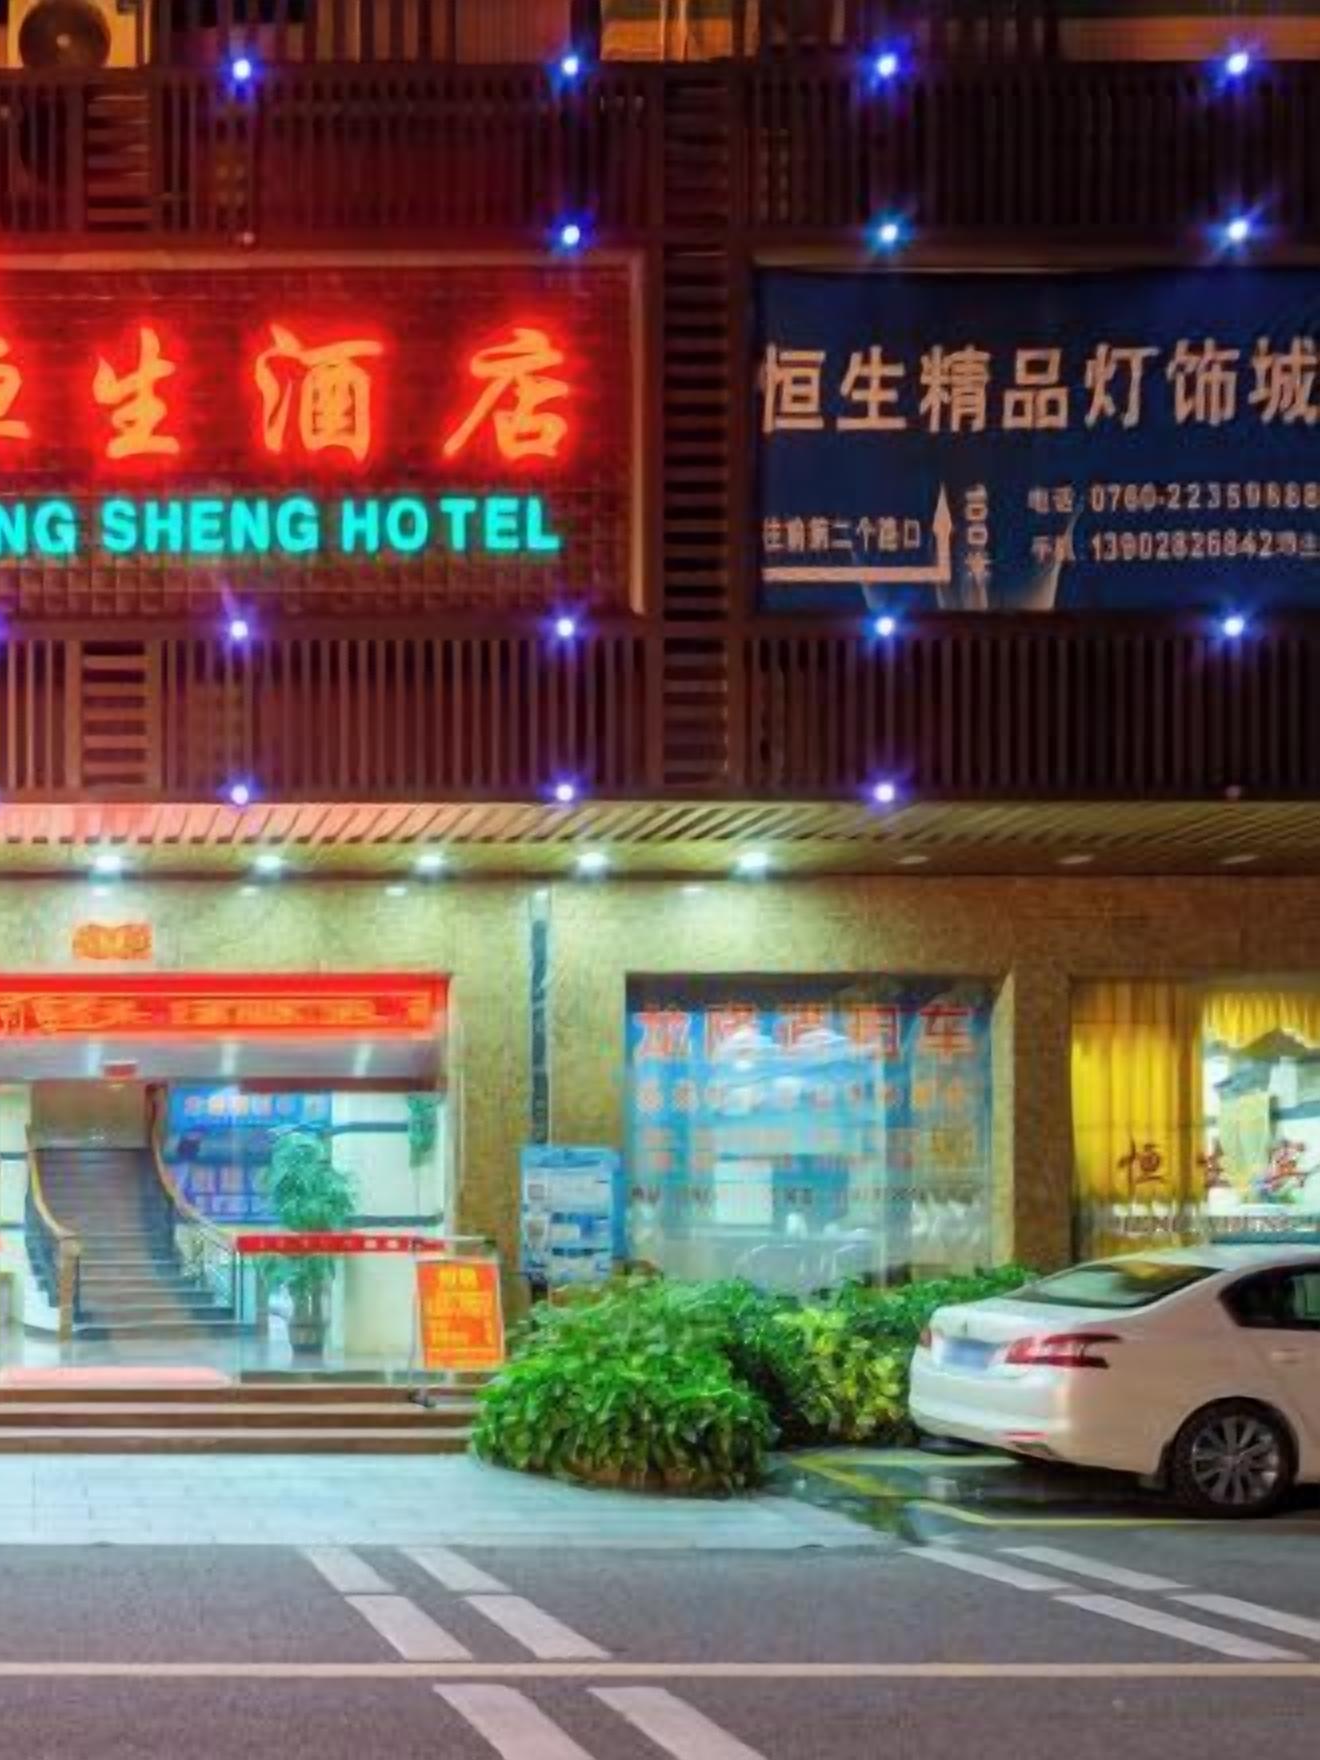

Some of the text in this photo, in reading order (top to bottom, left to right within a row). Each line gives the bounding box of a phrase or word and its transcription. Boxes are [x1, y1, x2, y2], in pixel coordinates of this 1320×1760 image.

[761, 336, 1320, 433] 恒生精品灯饰城
[101, 497, 320, 554] SHENG
[341, 496, 561, 552] HOTEL
